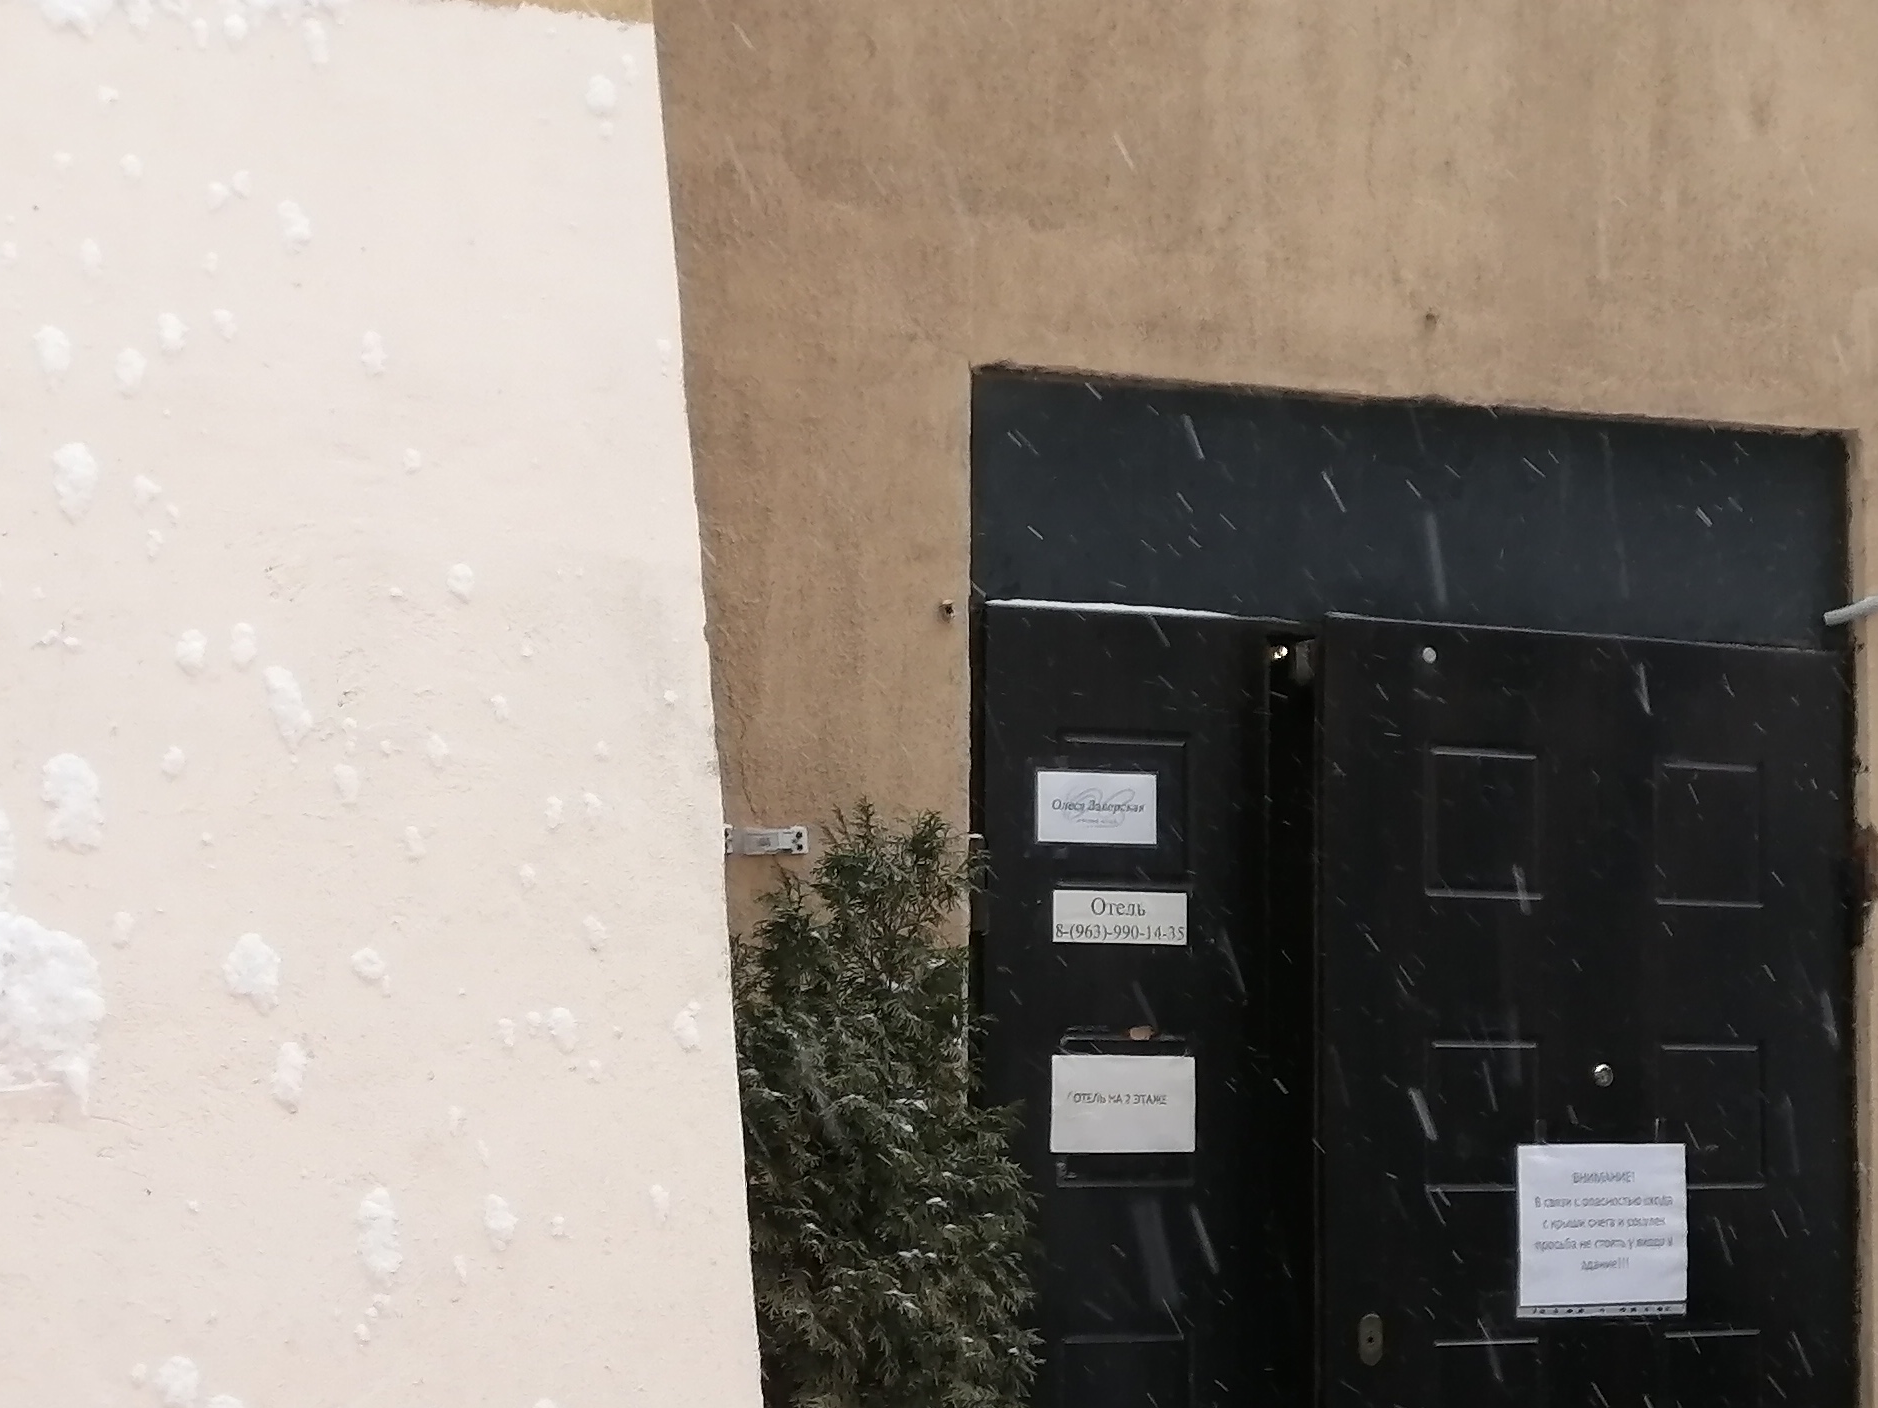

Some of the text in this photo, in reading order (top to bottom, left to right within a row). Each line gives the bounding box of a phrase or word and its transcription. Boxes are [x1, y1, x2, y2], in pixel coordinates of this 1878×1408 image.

[1090, 897, 1146, 916] Отель
[1055, 923, 1185, 941] 8-(963)-990-14-35
[1073, 1092, 1107, 1104] ОТЕЛЬ
